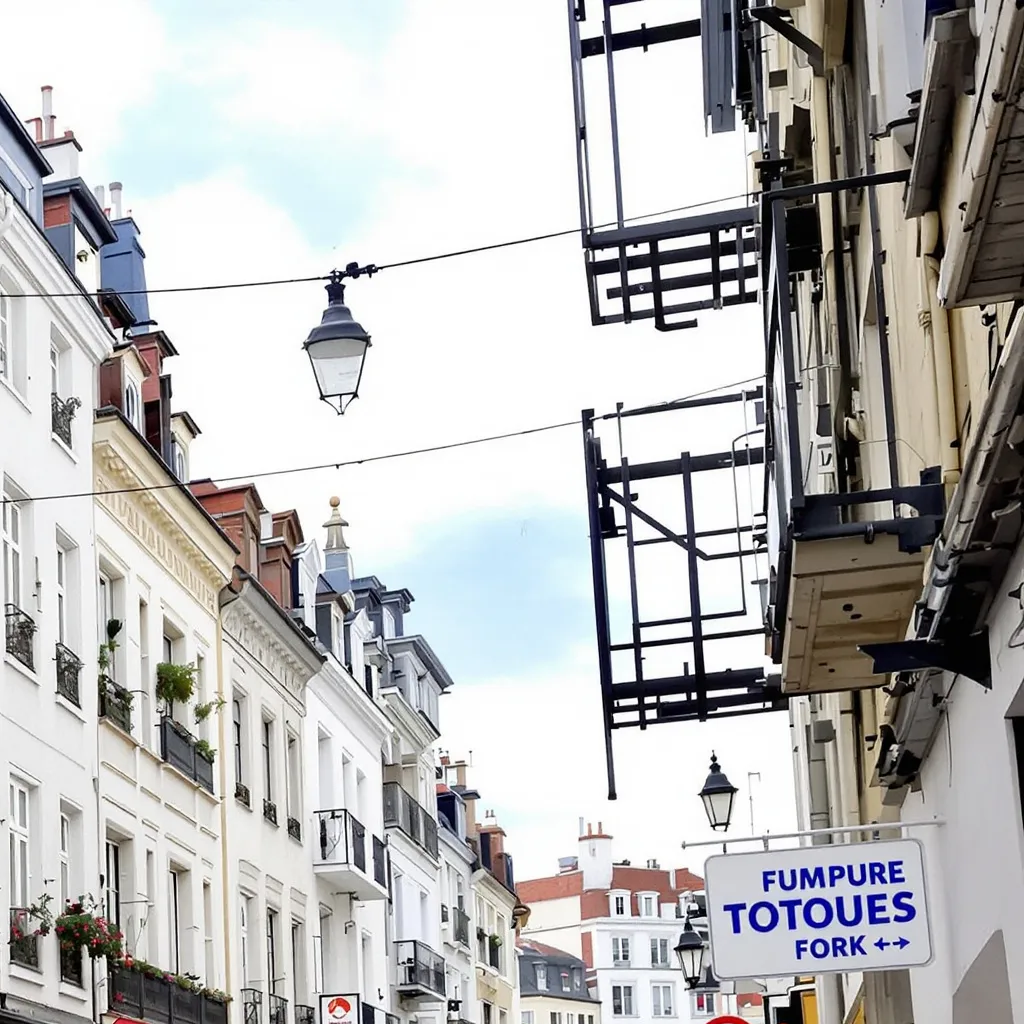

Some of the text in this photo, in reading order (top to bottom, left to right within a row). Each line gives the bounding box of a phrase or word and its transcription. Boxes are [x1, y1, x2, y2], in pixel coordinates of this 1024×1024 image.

[762, 861, 906, 892] FUMPURE
[723, 891, 916, 934] TOTOUES
[795, 935, 867, 960] FORK
